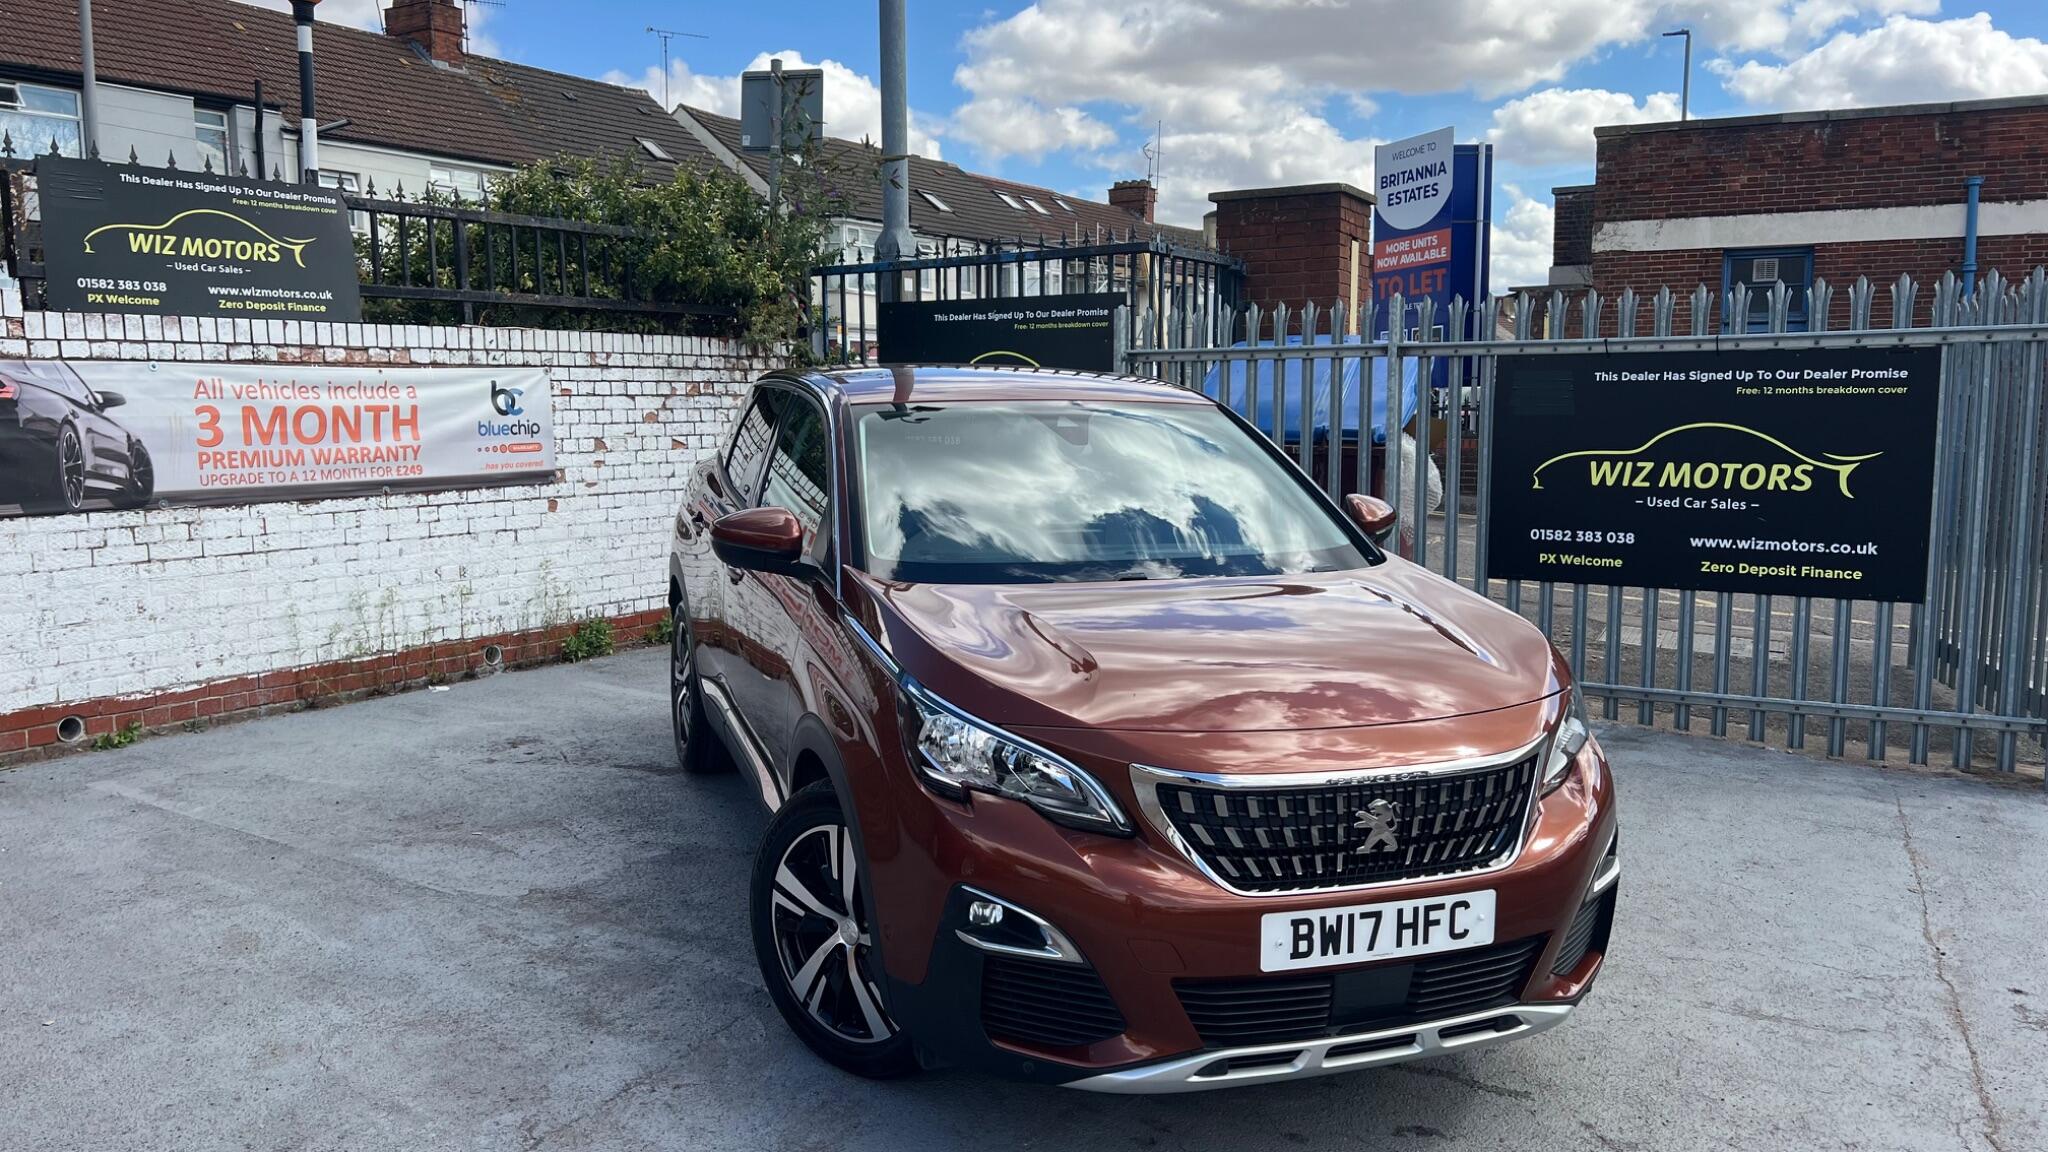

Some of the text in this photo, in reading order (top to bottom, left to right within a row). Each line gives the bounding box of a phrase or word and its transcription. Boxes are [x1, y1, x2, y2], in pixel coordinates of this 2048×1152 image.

[1392, 142, 1436, 161] WELCOME TO
[1380, 161, 1447, 190] BRITANNIA
[120, 173, 336, 204] This Dealer Has Signed Up To Our Dealer Promise
[1388, 183, 1439, 207] ESTATES
[284, 202, 319, 212] breakdown
[129, 232, 280, 262] WIZ MOTORS
[1386, 235, 1438, 254] MORE UNITS
[1377, 247, 1447, 269] NOW AVAILABLE
[175, 262, 242, 274] Used Car Sales
[77, 278, 167, 292] 01582 383 038
[208, 286, 332, 300] www.wizmotors.co.uk
[1377, 269, 1447, 300] TO LET
[88, 293, 160, 305] PX Welcome
[219, 300, 326, 312] Zero Deposit Finance
[988, 311, 1012, 321] Signed
[1014, 312, 1024, 320] Up
[1051, 310, 1074, 318] Dealer
[1077, 308, 1108, 317] Promise
[1595, 368, 1908, 383] This Dealer Has Signed Up To Our Dealer Promise
[194, 379, 417, 400] All vehicles include a
[197, 403, 420, 448] 3 MONTH
[478, 420, 540, 438] bluechip
[199, 444, 421, 470] PREMIUM WARRANTY
[199, 465, 423, 487] UPGRADE TO A 12 MONTH FOR £249
[1590, 461, 1814, 491] WIZ MOTORS
[1647, 497, 1746, 510] Used Car Sales
[1530, 529, 1635, 544] 01582 383 038
[1690, 536, 1878, 556] www.wizmotors.co.uk
[1540, 553, 1623, 567] PX Welcome
[1700, 561, 1862, 580] Zero Deposit Finance
[1339, 775, 1422, 785] PEUGEOT
[1290, 900, 1470, 960] BW17 HFC
